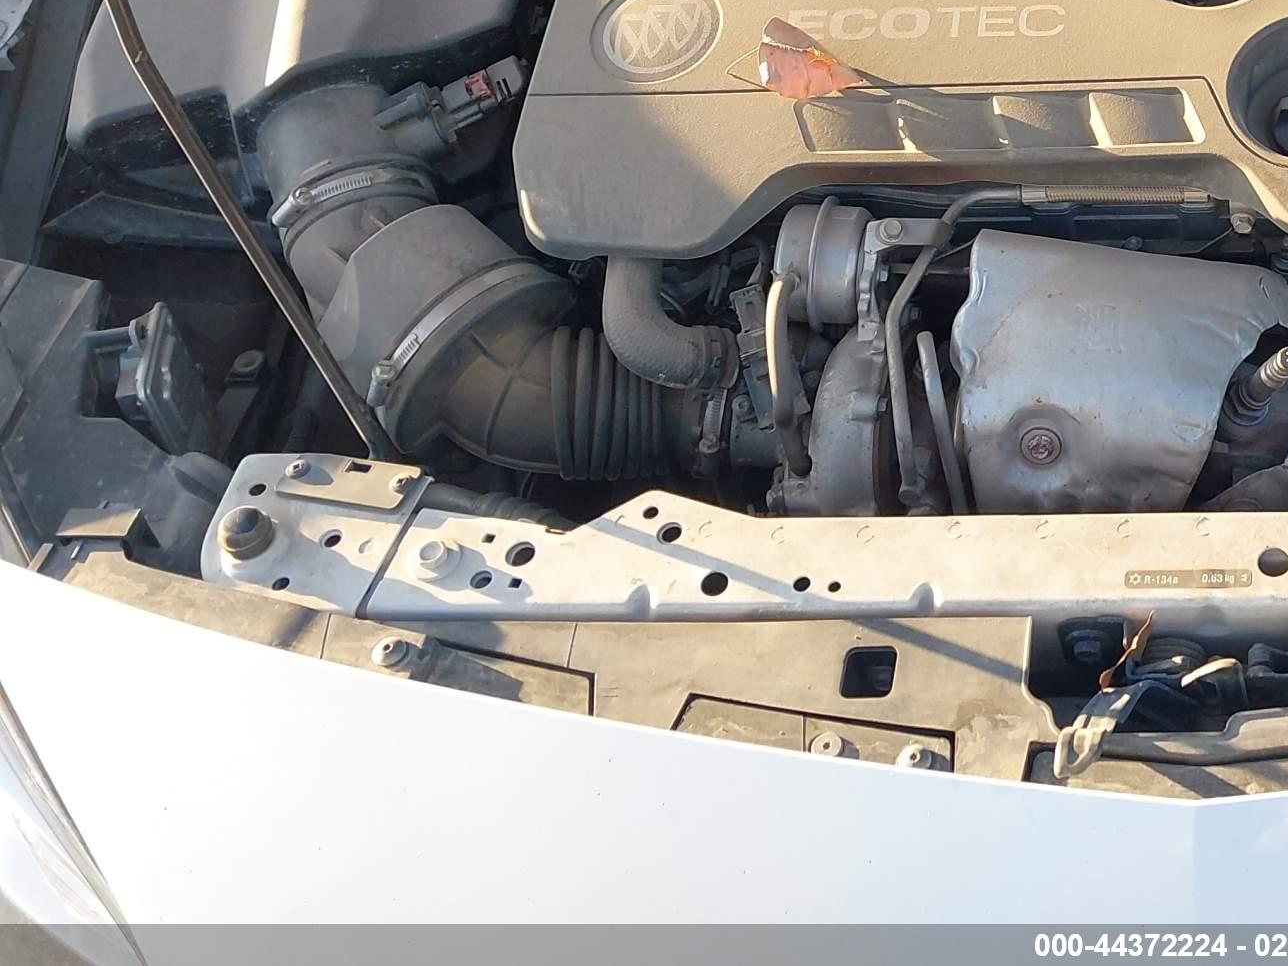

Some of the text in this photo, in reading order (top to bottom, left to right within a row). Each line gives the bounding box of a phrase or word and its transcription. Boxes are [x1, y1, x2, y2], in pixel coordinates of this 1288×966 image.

[785, 4, 1066, 40] ECOTEC
[1144, 573, 1235, 585] R-134a 0.63 kg
